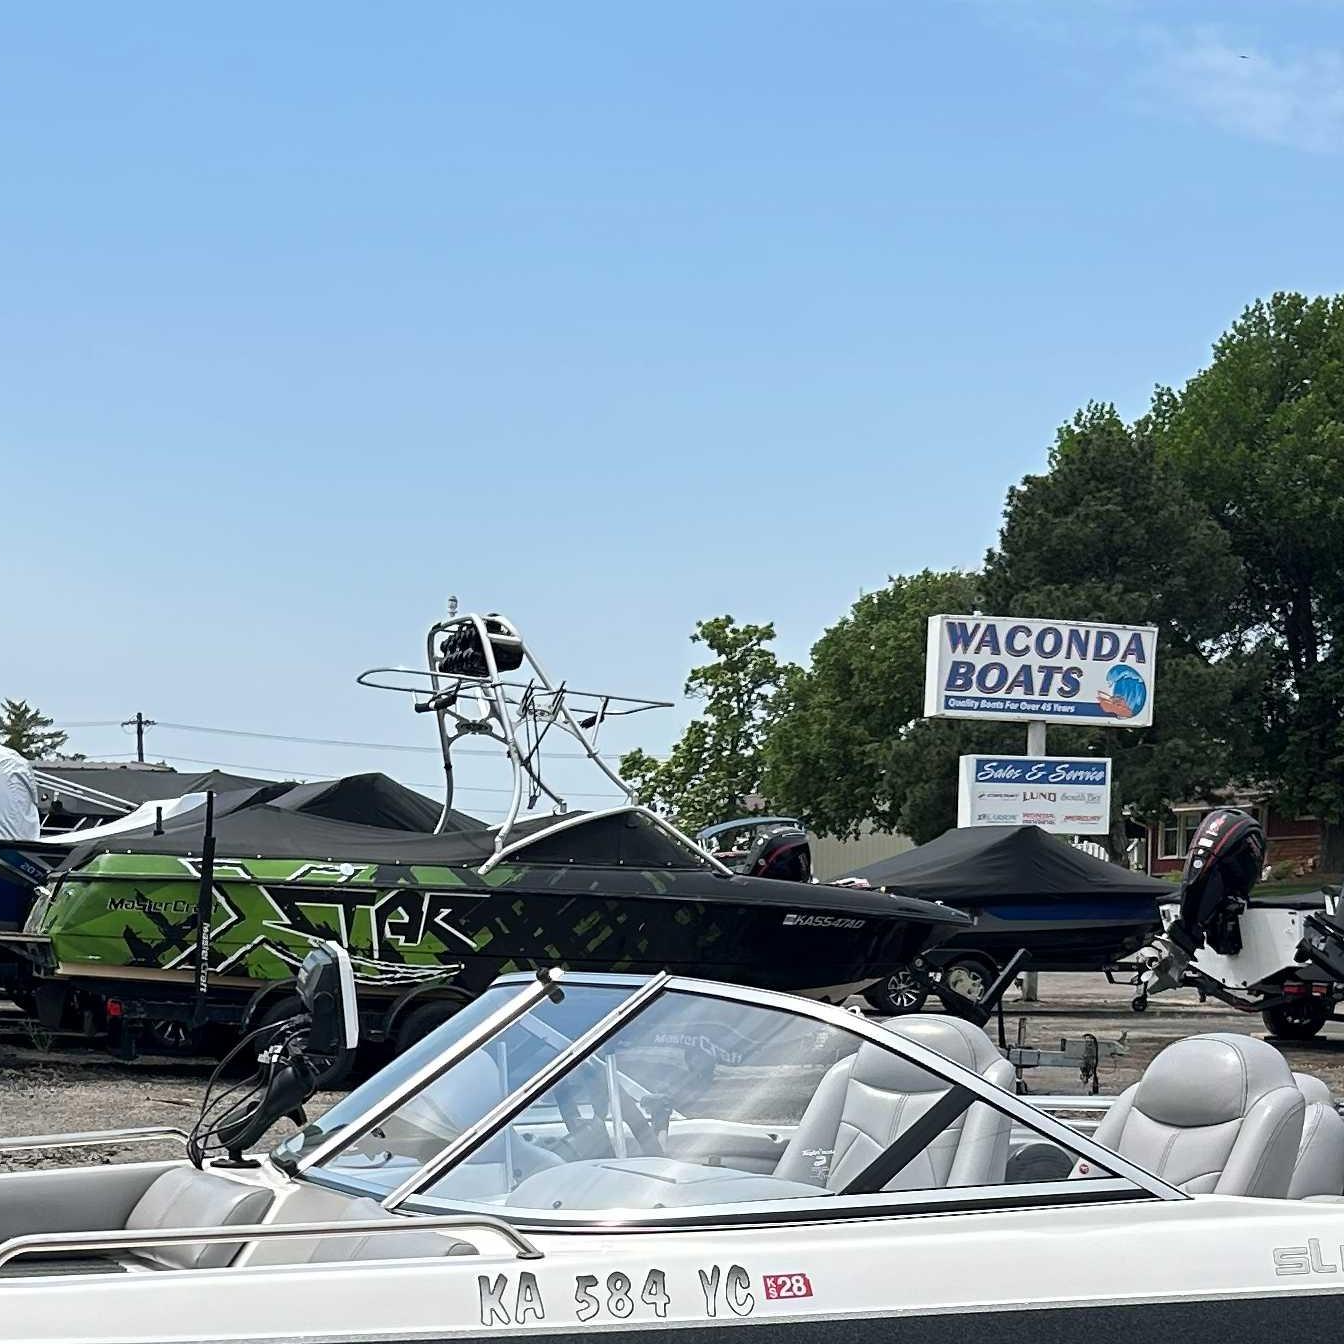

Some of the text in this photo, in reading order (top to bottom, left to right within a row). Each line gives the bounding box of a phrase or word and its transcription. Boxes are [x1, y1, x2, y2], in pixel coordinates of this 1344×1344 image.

[945, 621, 1146, 664] WACONDA
[944, 660, 1084, 698] BOATS
[947, 698, 1076, 713] Quality Boats For Over 45 Years
[977, 761, 1105, 783] Sales & Service
[1022, 791, 1056, 803] LUND
[106, 897, 220, 915] MasterCrat
[199, 922, 211, 993] Master Craft
[477, 1264, 755, 1327] KA 584 YC
[777, 1274, 807, 1297] 28
